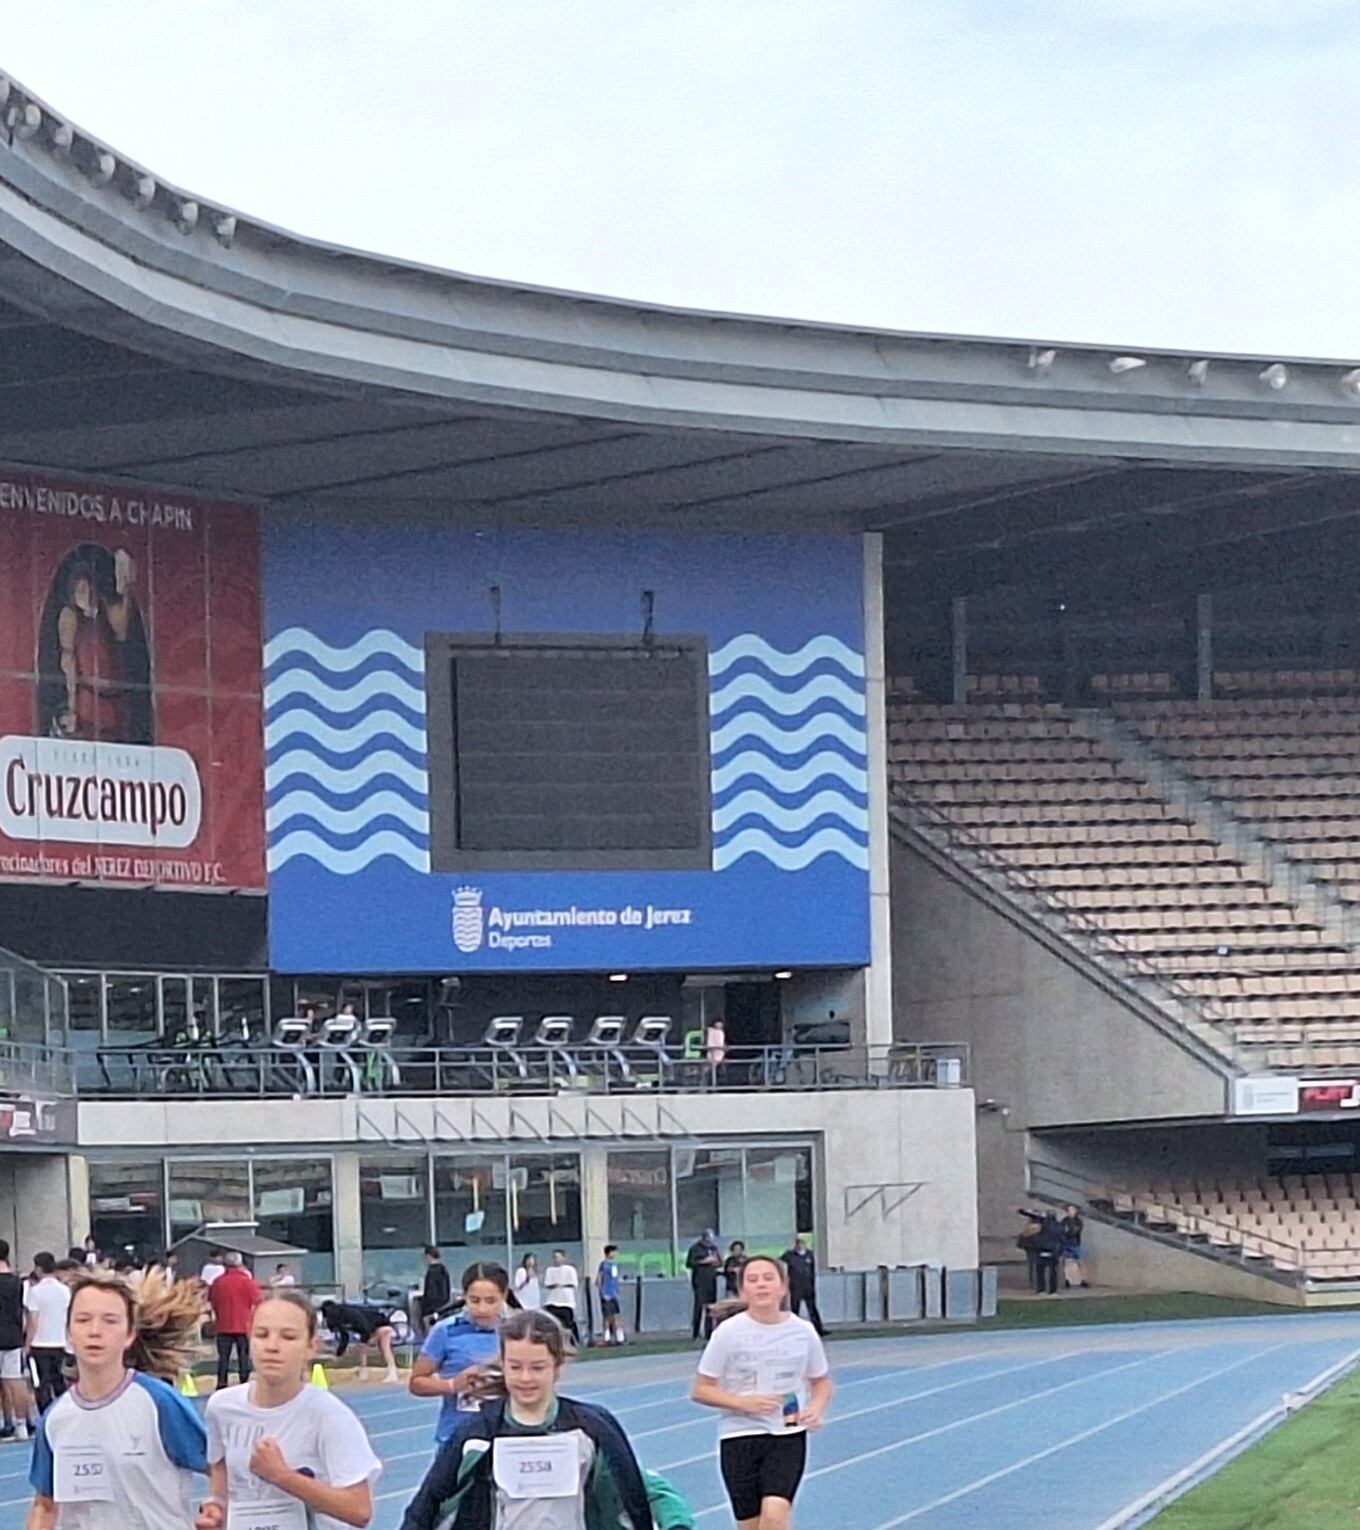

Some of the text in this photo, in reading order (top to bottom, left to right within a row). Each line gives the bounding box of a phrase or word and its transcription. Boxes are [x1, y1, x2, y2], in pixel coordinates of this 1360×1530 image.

[109, 498, 123, 523] A
[6, 753, 188, 837] Cruzcampo
[488, 906, 617, 932] Ayuntamiento
